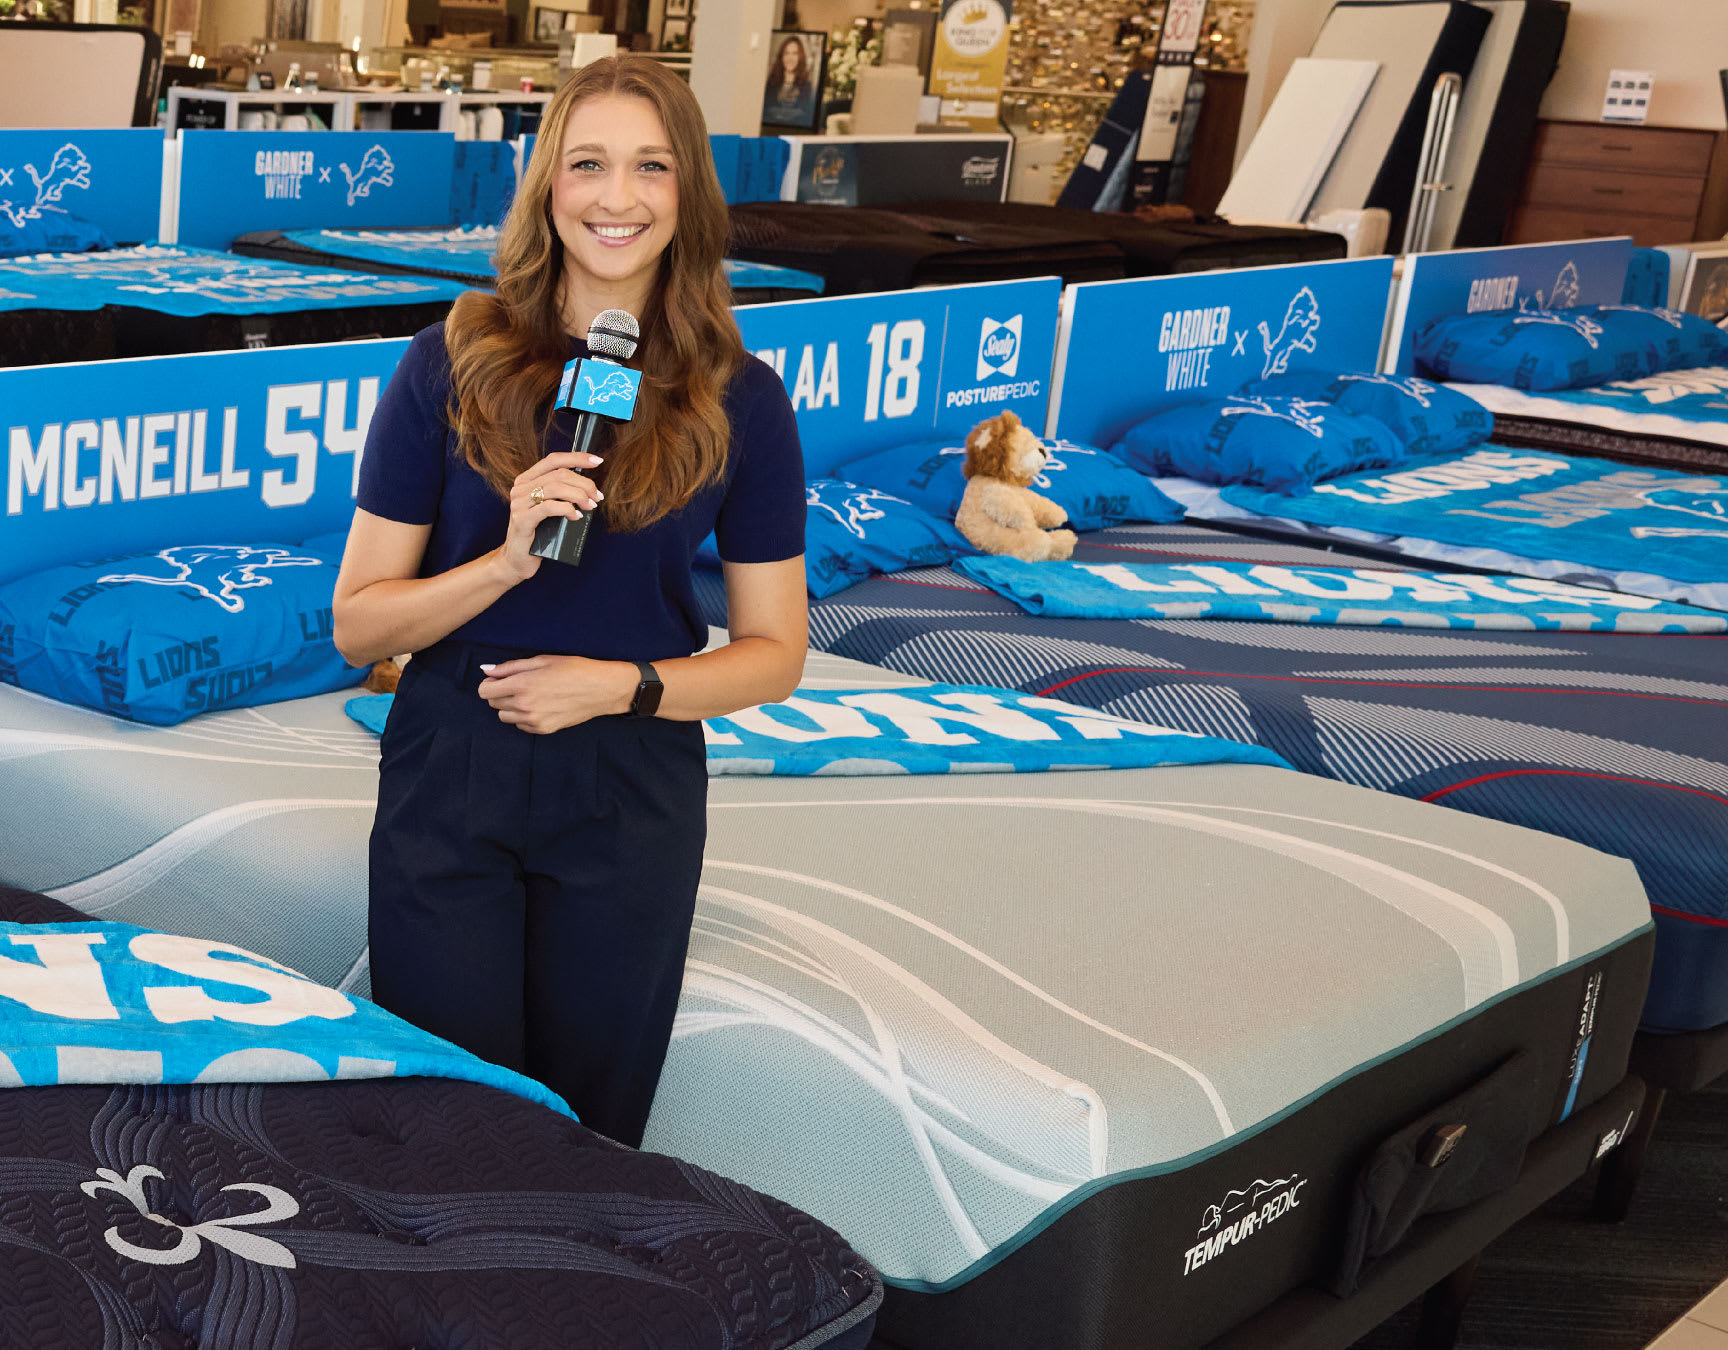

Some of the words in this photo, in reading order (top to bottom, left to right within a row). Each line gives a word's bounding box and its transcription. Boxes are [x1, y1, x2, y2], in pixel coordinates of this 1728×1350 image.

[255, 151, 314, 176] GARDNER
[265, 174, 302, 199] WHITE
[1468, 276, 1520, 314] GARDNER
[983, 332, 1015, 361] Sealy
[1158, 306, 1231, 352] GARDNER
[864, 319, 926, 422] 18
[1165, 347, 1214, 392] WHITE
[946, 380, 1040, 408] POSTUREPEDIC
[6, 407, 250, 514] MCNEILL
[259, 377, 380, 508] 54
[138, 635, 221, 691] LIONS
[1183, 1179, 1308, 1277] TEMPUR-PEDIC
